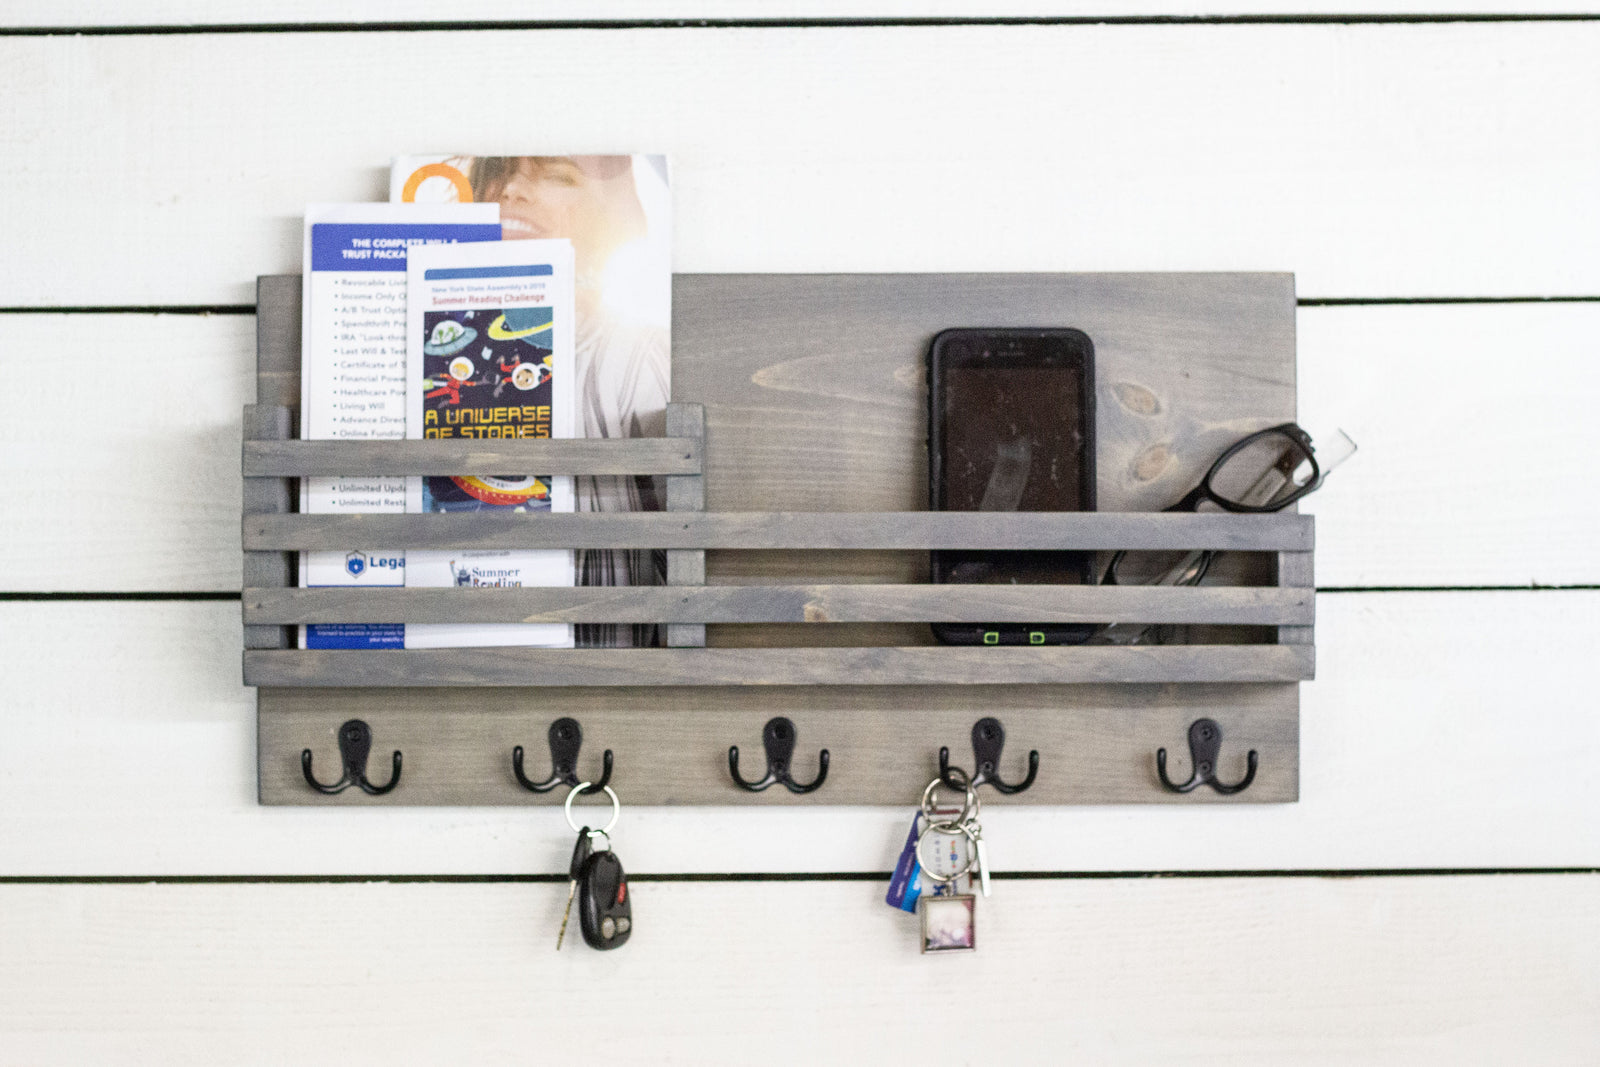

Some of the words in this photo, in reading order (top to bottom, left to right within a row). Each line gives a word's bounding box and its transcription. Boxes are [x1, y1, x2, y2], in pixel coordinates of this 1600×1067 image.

[352, 238, 371, 248] THE
[372, 238, 426, 248] COMPLETE
[342, 249, 372, 259] TRUST
[373, 249, 407, 259] PACKA
[341, 278, 386, 286] Revocable
[341, 292, 372, 300] Income
[375, 292, 395, 302] Only
[432, 296, 466, 305] Summer
[468, 295, 502, 304] Reading
[504, 293, 545, 303] Challenge
[341, 306, 358, 314] A/B
[341, 319, 390, 328] Spendthrift
[341, 333, 356, 341] IRA
[340, 347, 358, 355] Last
[340, 360, 385, 368] Certificate
[389, 360, 398, 368] of
[340, 374, 379, 382] Financial
[340, 388, 387, 396] Healthcare
[340, 402, 366, 411] Living
[425, 409, 438, 426] A
[340, 429, 369, 437] Online
[425, 427, 454, 439] OF
[460, 424, 550, 439] STORIES
[339, 484, 382, 493] Unlimited
[339, 498, 382, 506] Unlimited
[472, 567, 520, 578] Summer
[472, 577, 522, 588] Reading
